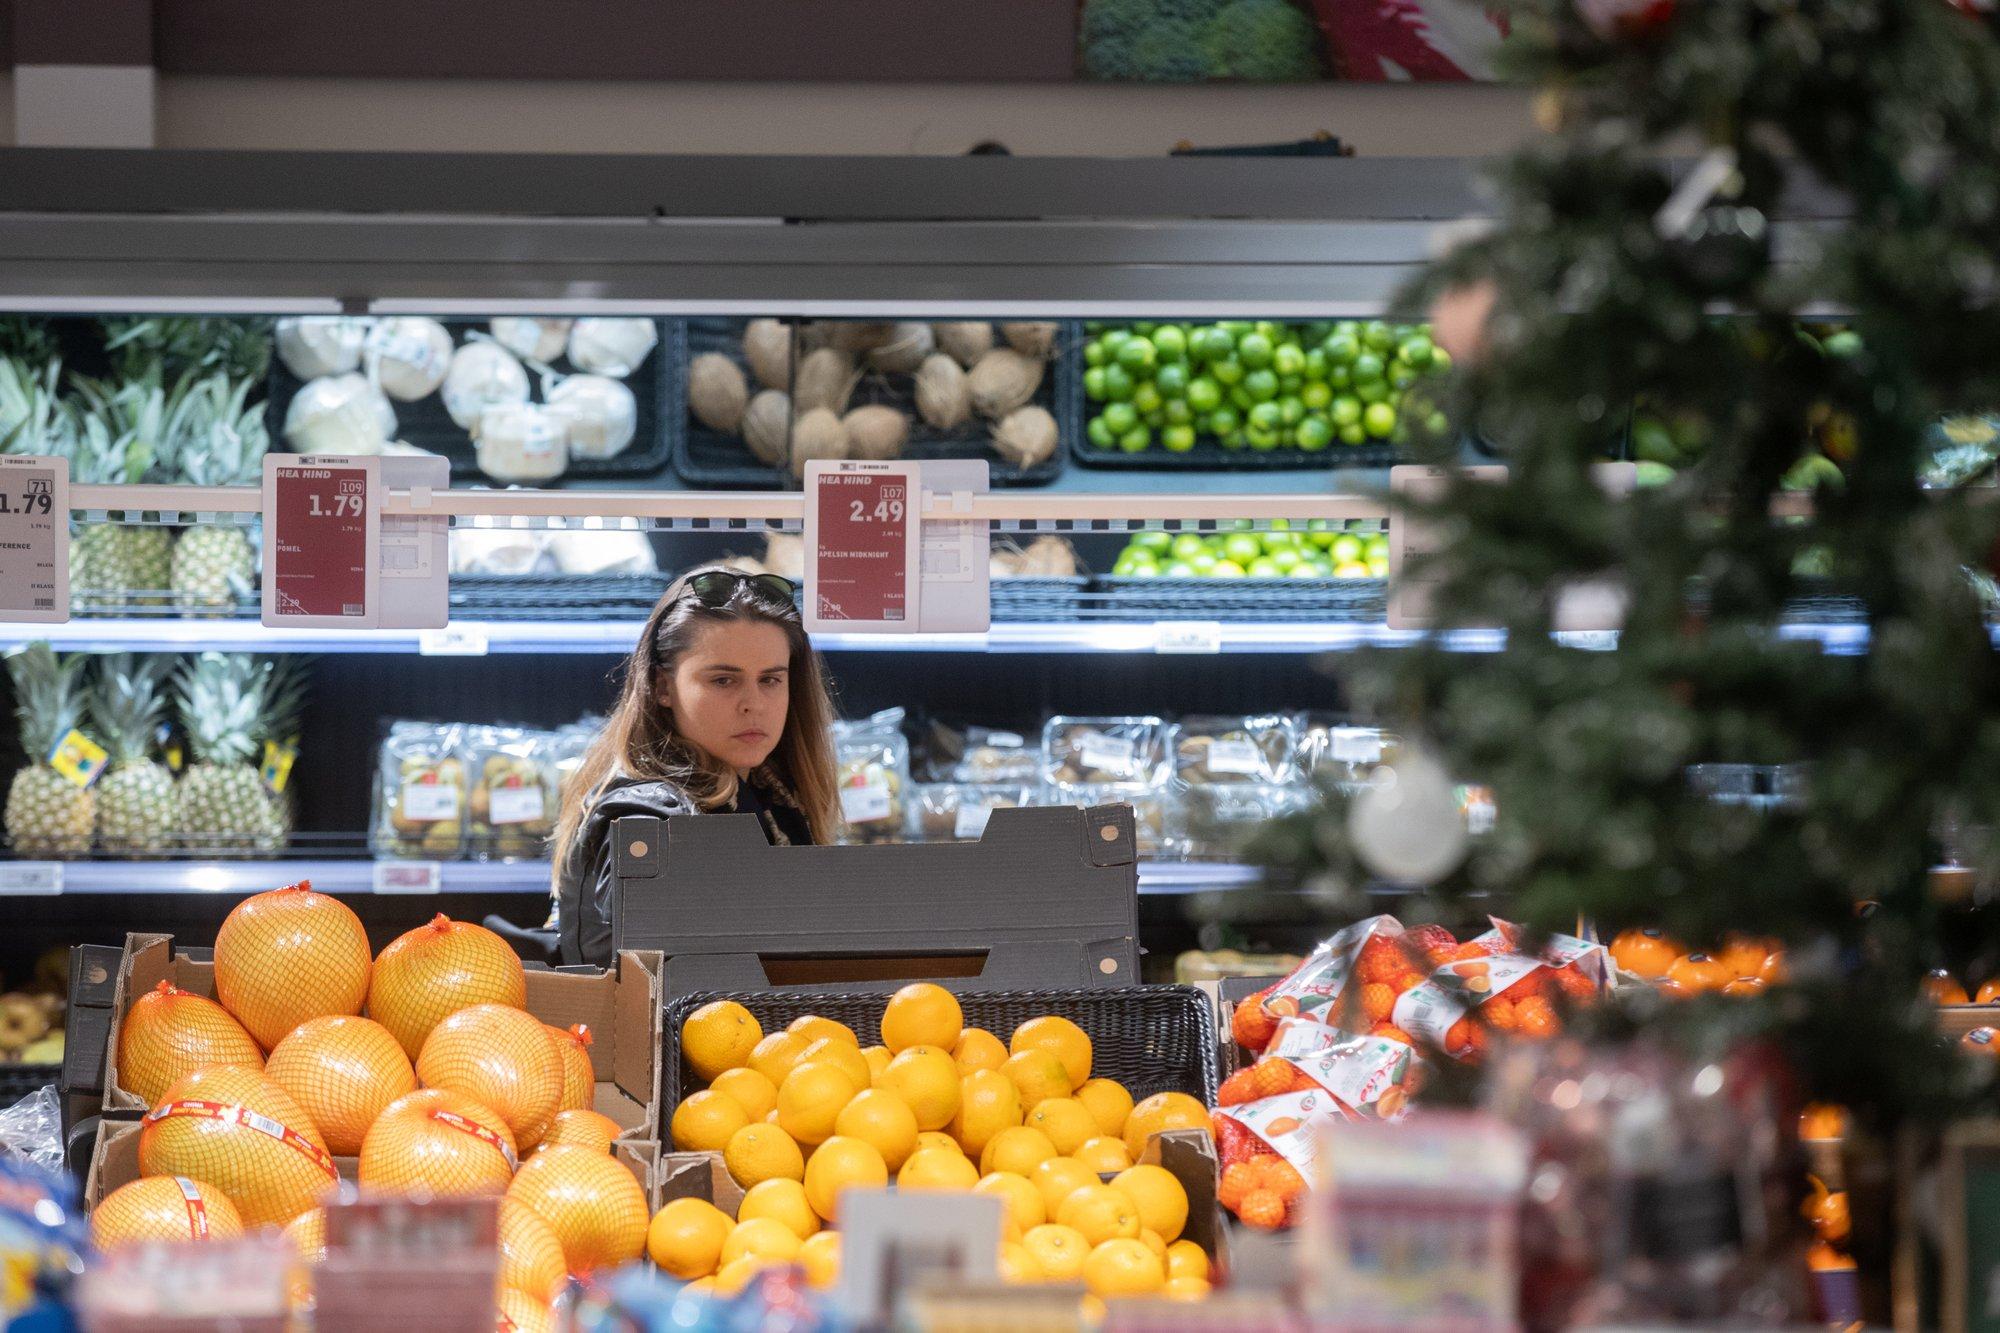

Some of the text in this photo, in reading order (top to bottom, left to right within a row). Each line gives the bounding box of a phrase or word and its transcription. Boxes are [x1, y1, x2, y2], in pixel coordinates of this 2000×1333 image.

[277, 469, 331, 479] HEA HIND
[818, 475, 872, 485] HEA HIND
[32, 482, 48, 494] 71
[342, 482, 361, 493] 109
[883, 488, 902, 499] 107
[0, 493, 52, 515] 1.79
[309, 494, 363, 517] 1.79
[849, 499, 904, 523] 2.49
